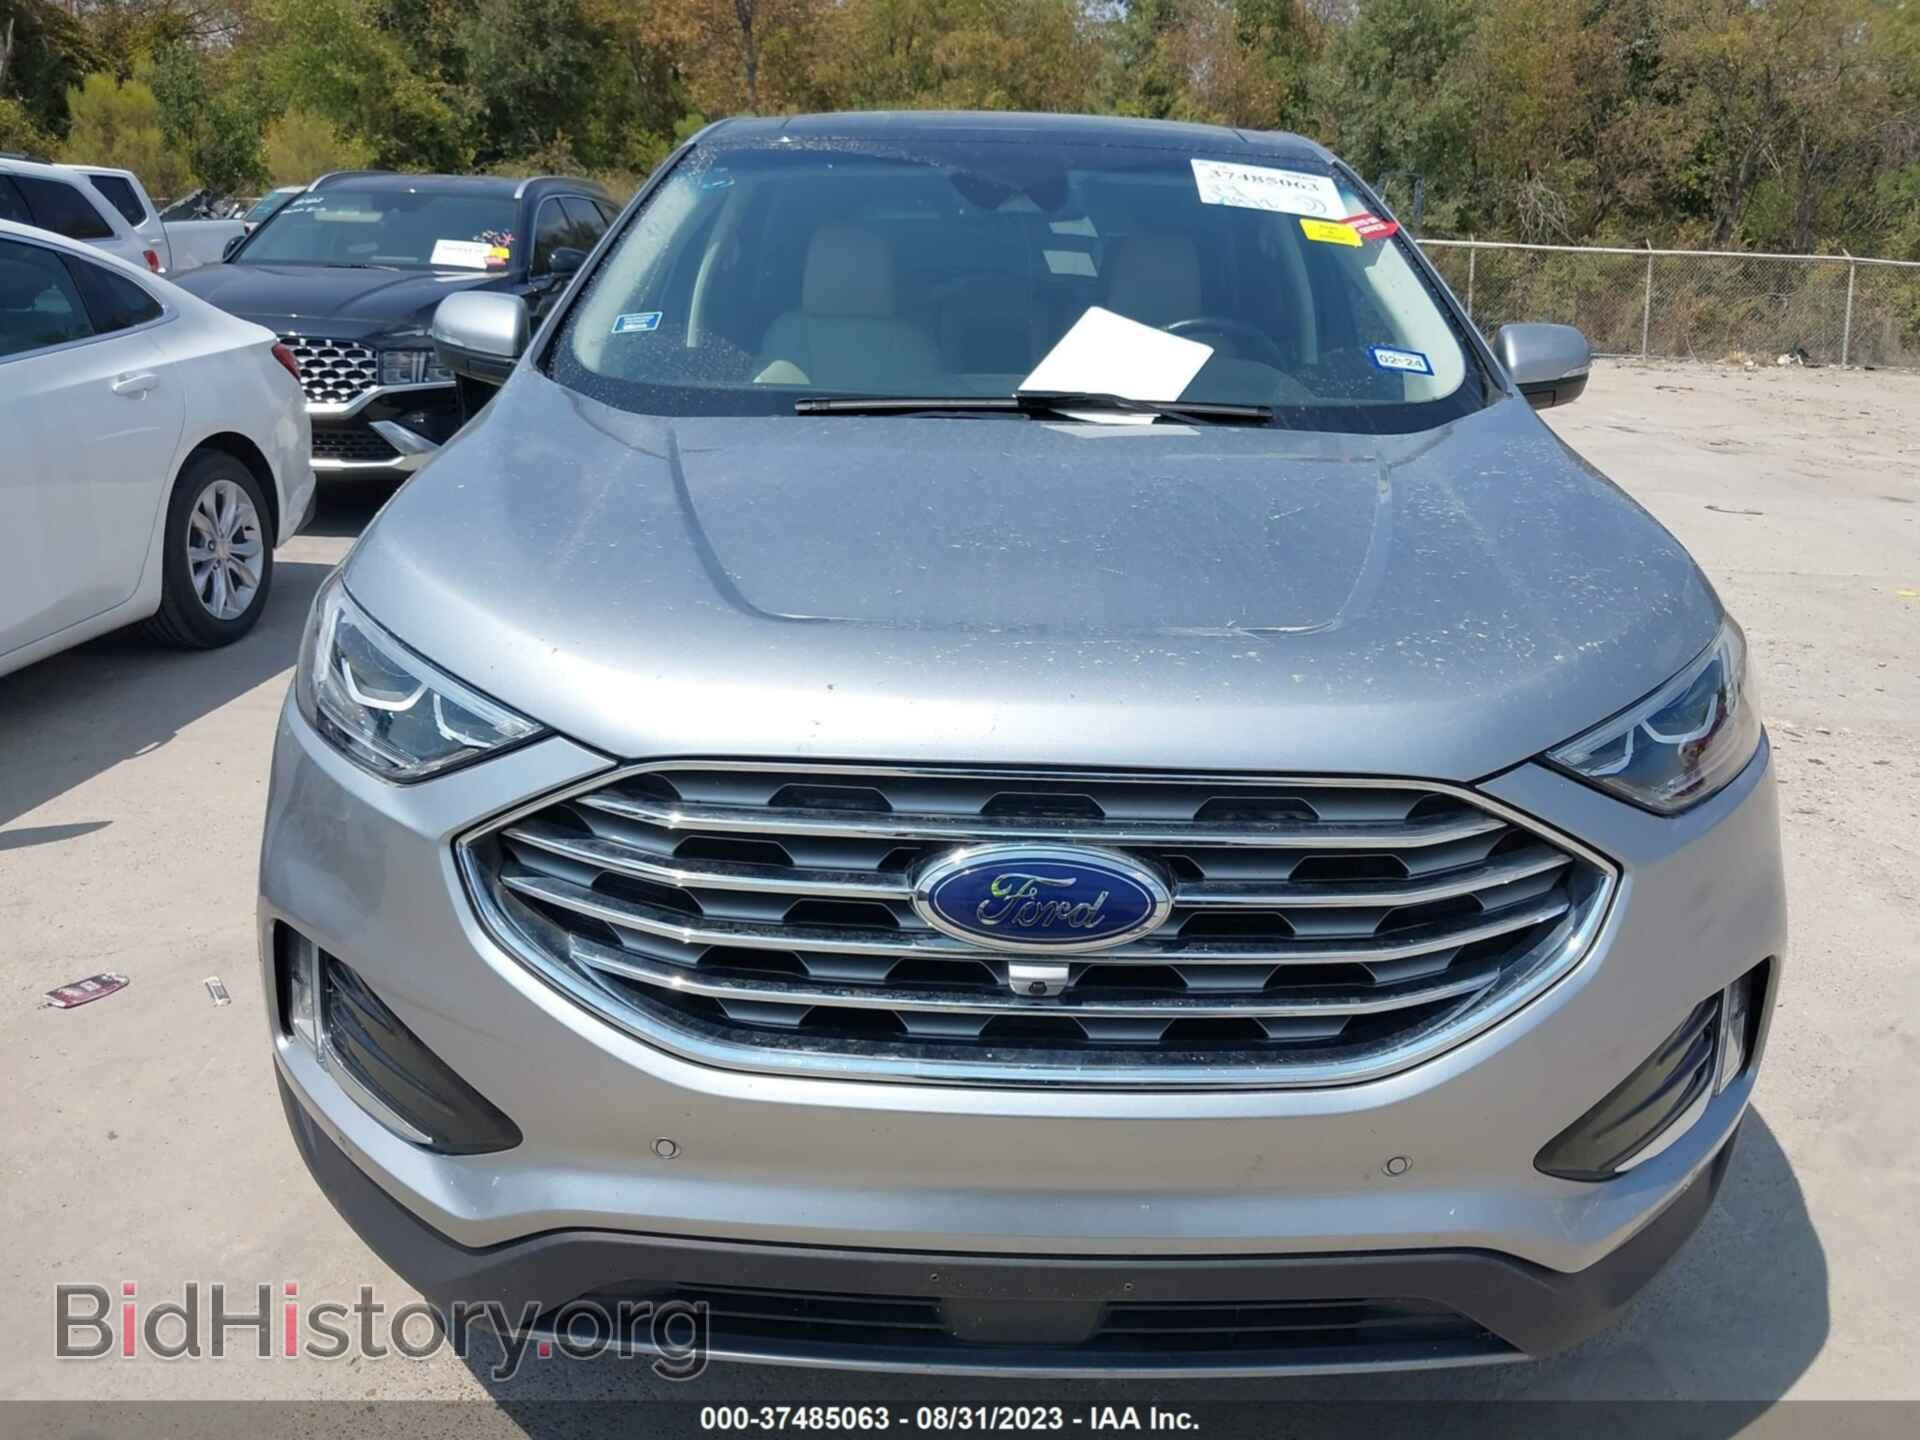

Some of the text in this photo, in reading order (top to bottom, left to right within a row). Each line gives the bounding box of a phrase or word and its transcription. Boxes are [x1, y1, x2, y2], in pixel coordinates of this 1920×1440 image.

[1209, 168, 1320, 192] 37485063
[1379, 353, 1424, 369] 02-24
[976, 872, 1109, 929] Ford
